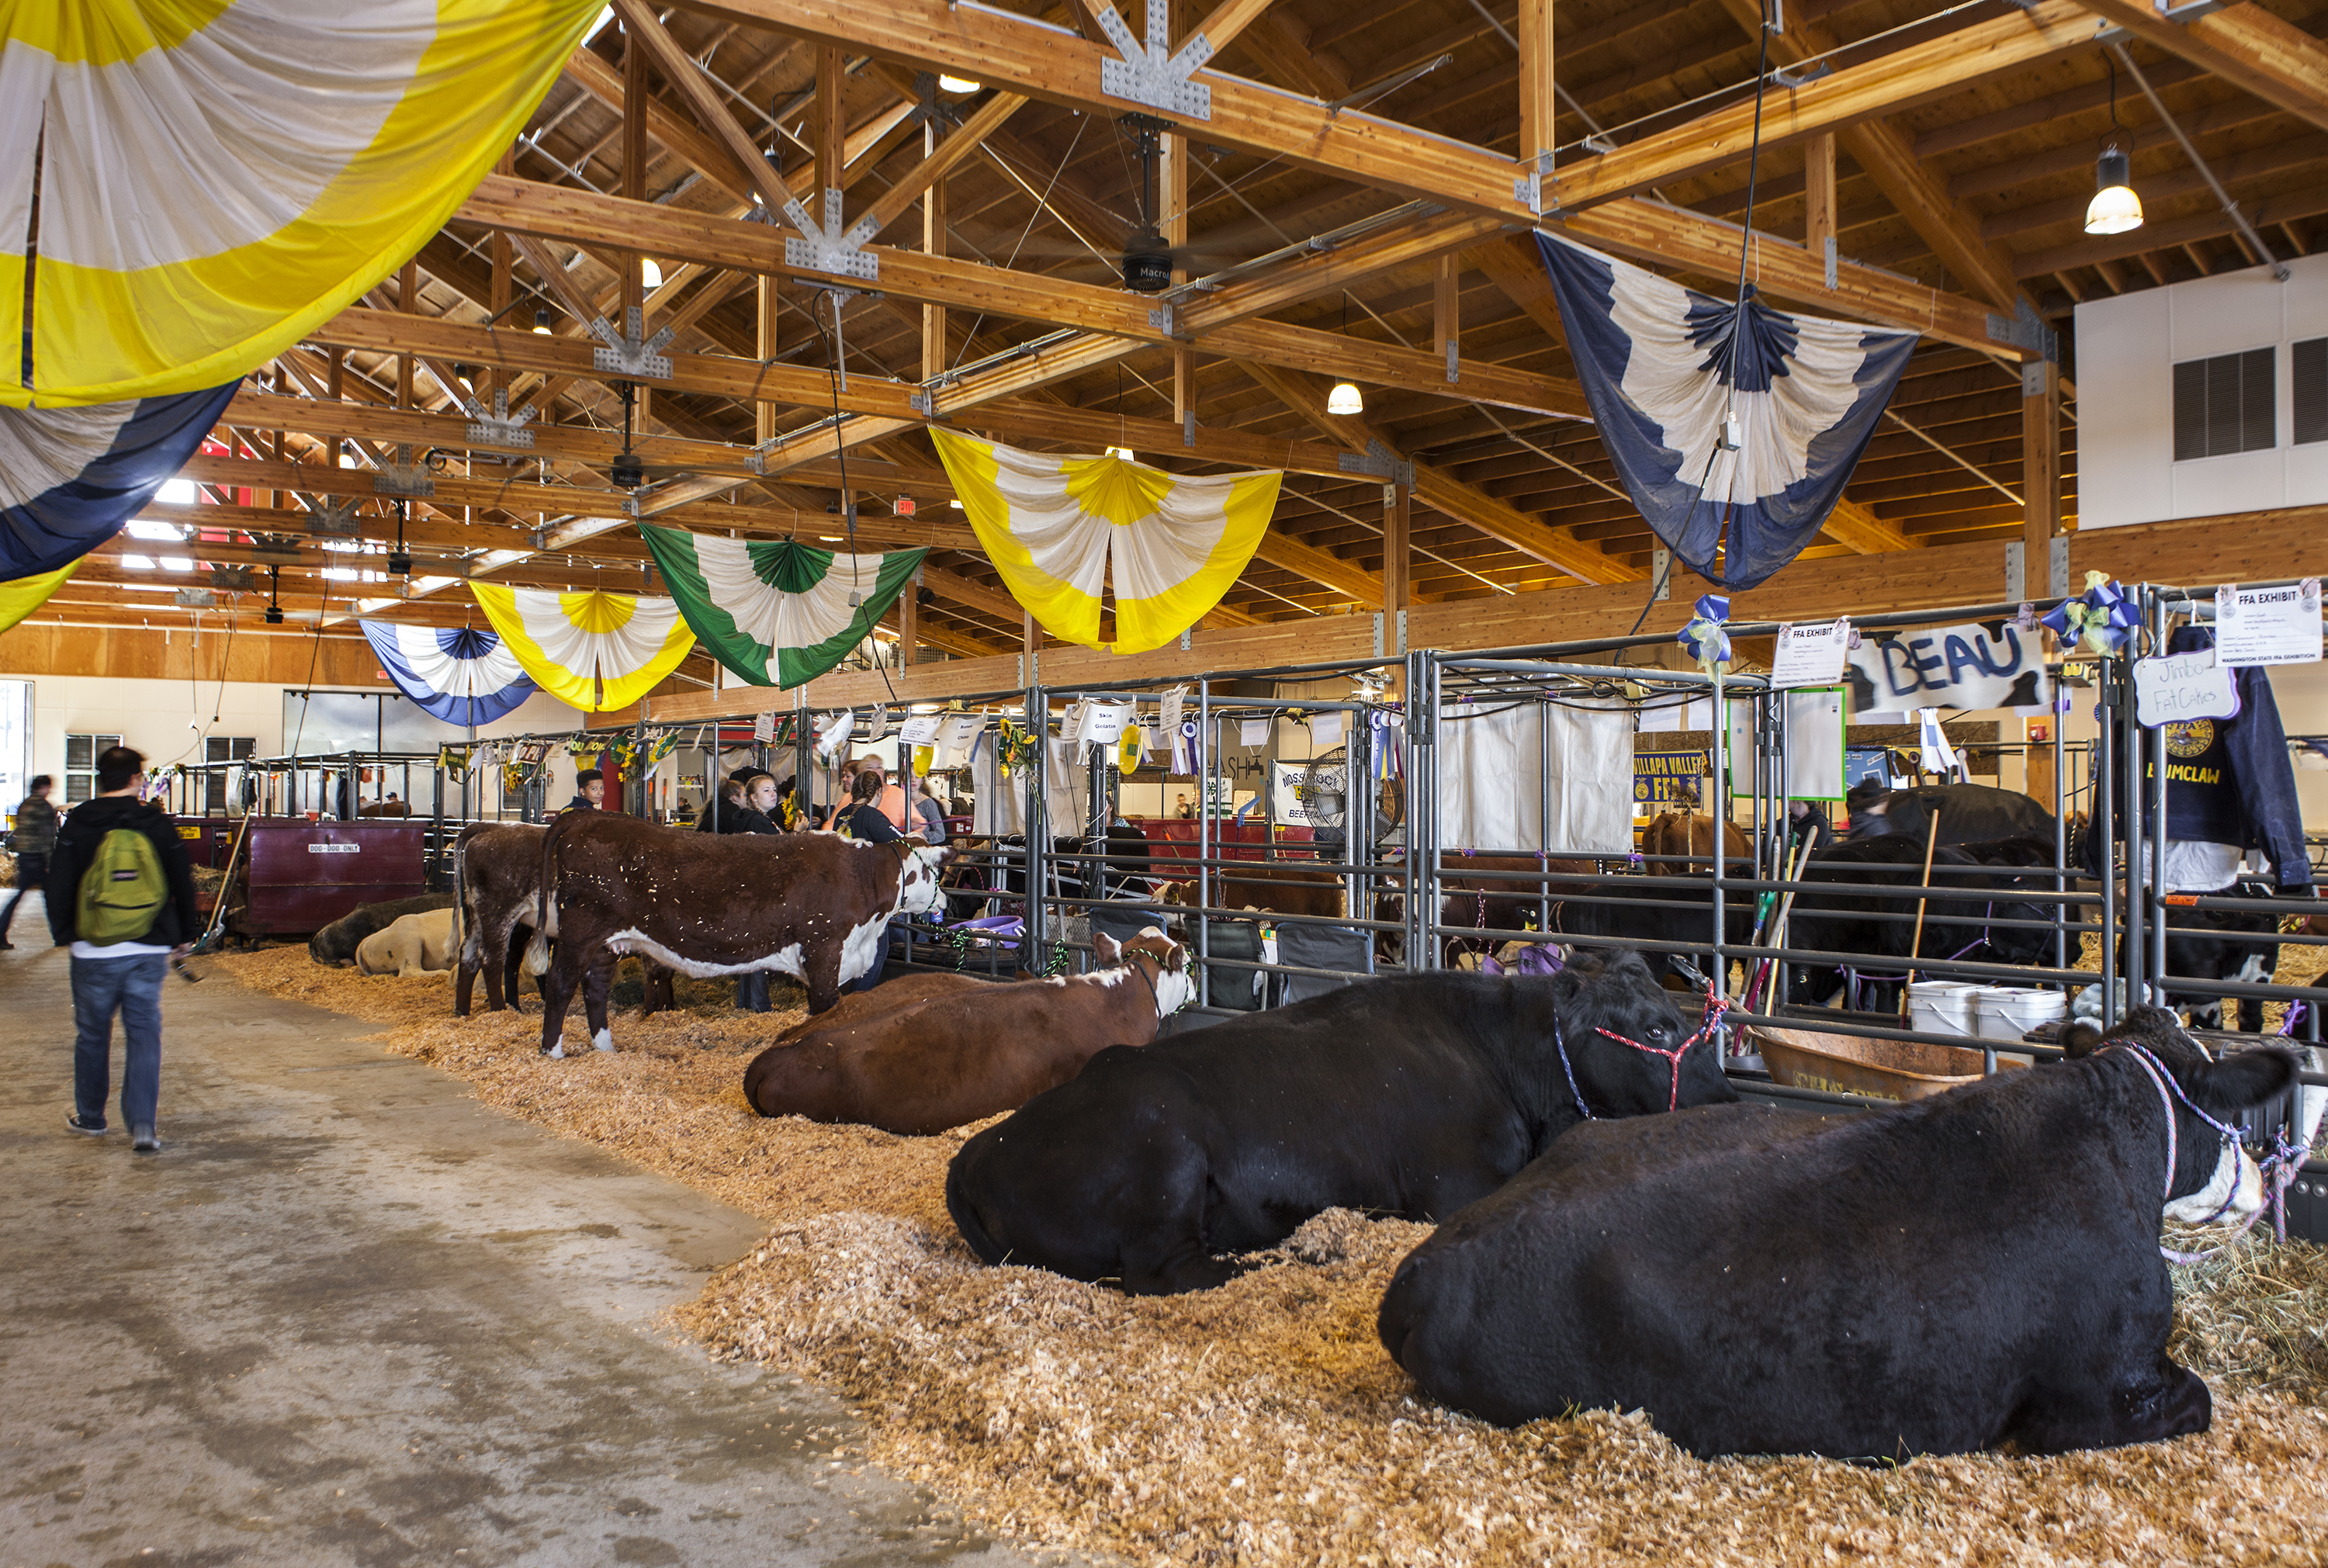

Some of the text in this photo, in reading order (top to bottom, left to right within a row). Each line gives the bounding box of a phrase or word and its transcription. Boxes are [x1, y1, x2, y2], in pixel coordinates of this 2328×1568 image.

[899, 501, 913, 514] EXIT
[2239, 590, 2297, 605] FFA EXHIBIT
[1793, 627, 1833, 639] FFA EXHIBIT
[1881, 628, 2023, 696] BEAU
[2159, 659, 2204, 683] Jimbo
[570, 739, 585, 752] OU
[1668, 756, 1702, 775] VALLEY
[2146, 762, 2220, 784] EUMCLAW
[1282, 773, 1338, 787] MOSSOCK
